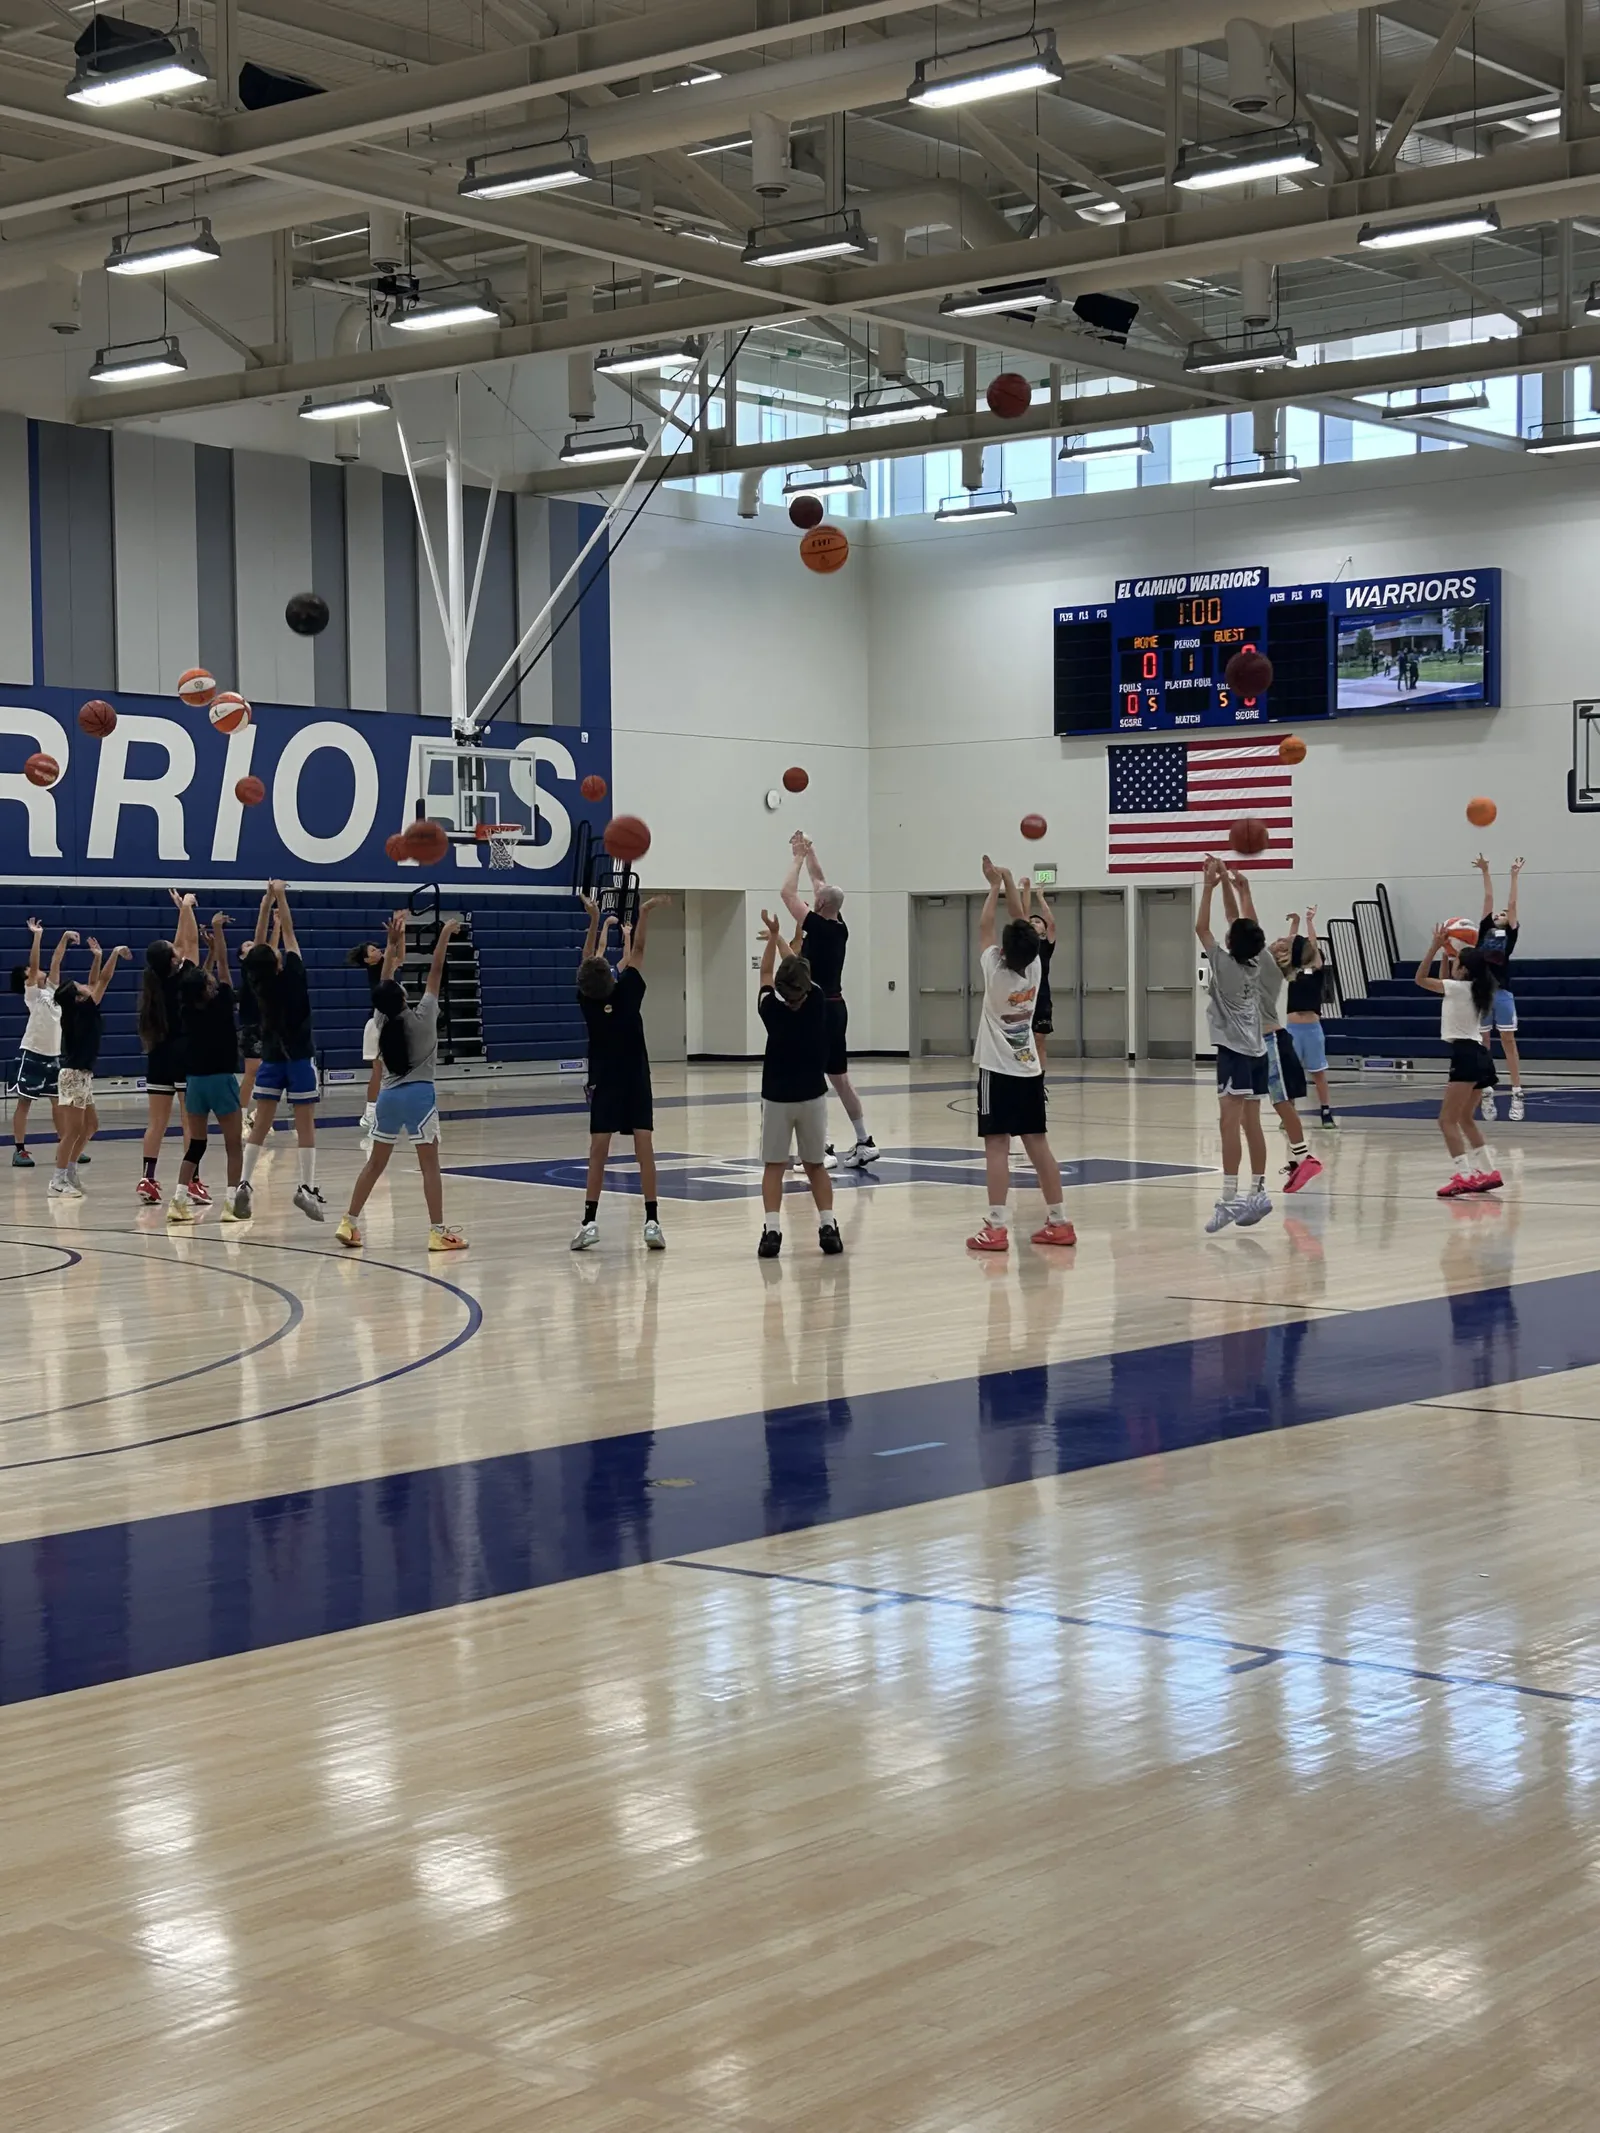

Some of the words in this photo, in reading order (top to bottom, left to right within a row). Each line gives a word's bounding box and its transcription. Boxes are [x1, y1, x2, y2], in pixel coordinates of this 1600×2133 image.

[1117, 583, 1131, 599] EL
[1134, 577, 1187, 598] CAMINO
[1189, 569, 1261, 592] WARRIORS
[1345, 576, 1477, 609] WARRIORS
[1179, 597, 1221, 626] 1:00
[1133, 635, 1159, 649] HOME
[1214, 628, 1246, 643] GUEST
[1143, 652, 1157, 679] 0
[1119, 683, 1142, 693] FOULS
[1194, 677, 1213, 688] FOUL
[1127, 694, 1139, 714] 0
